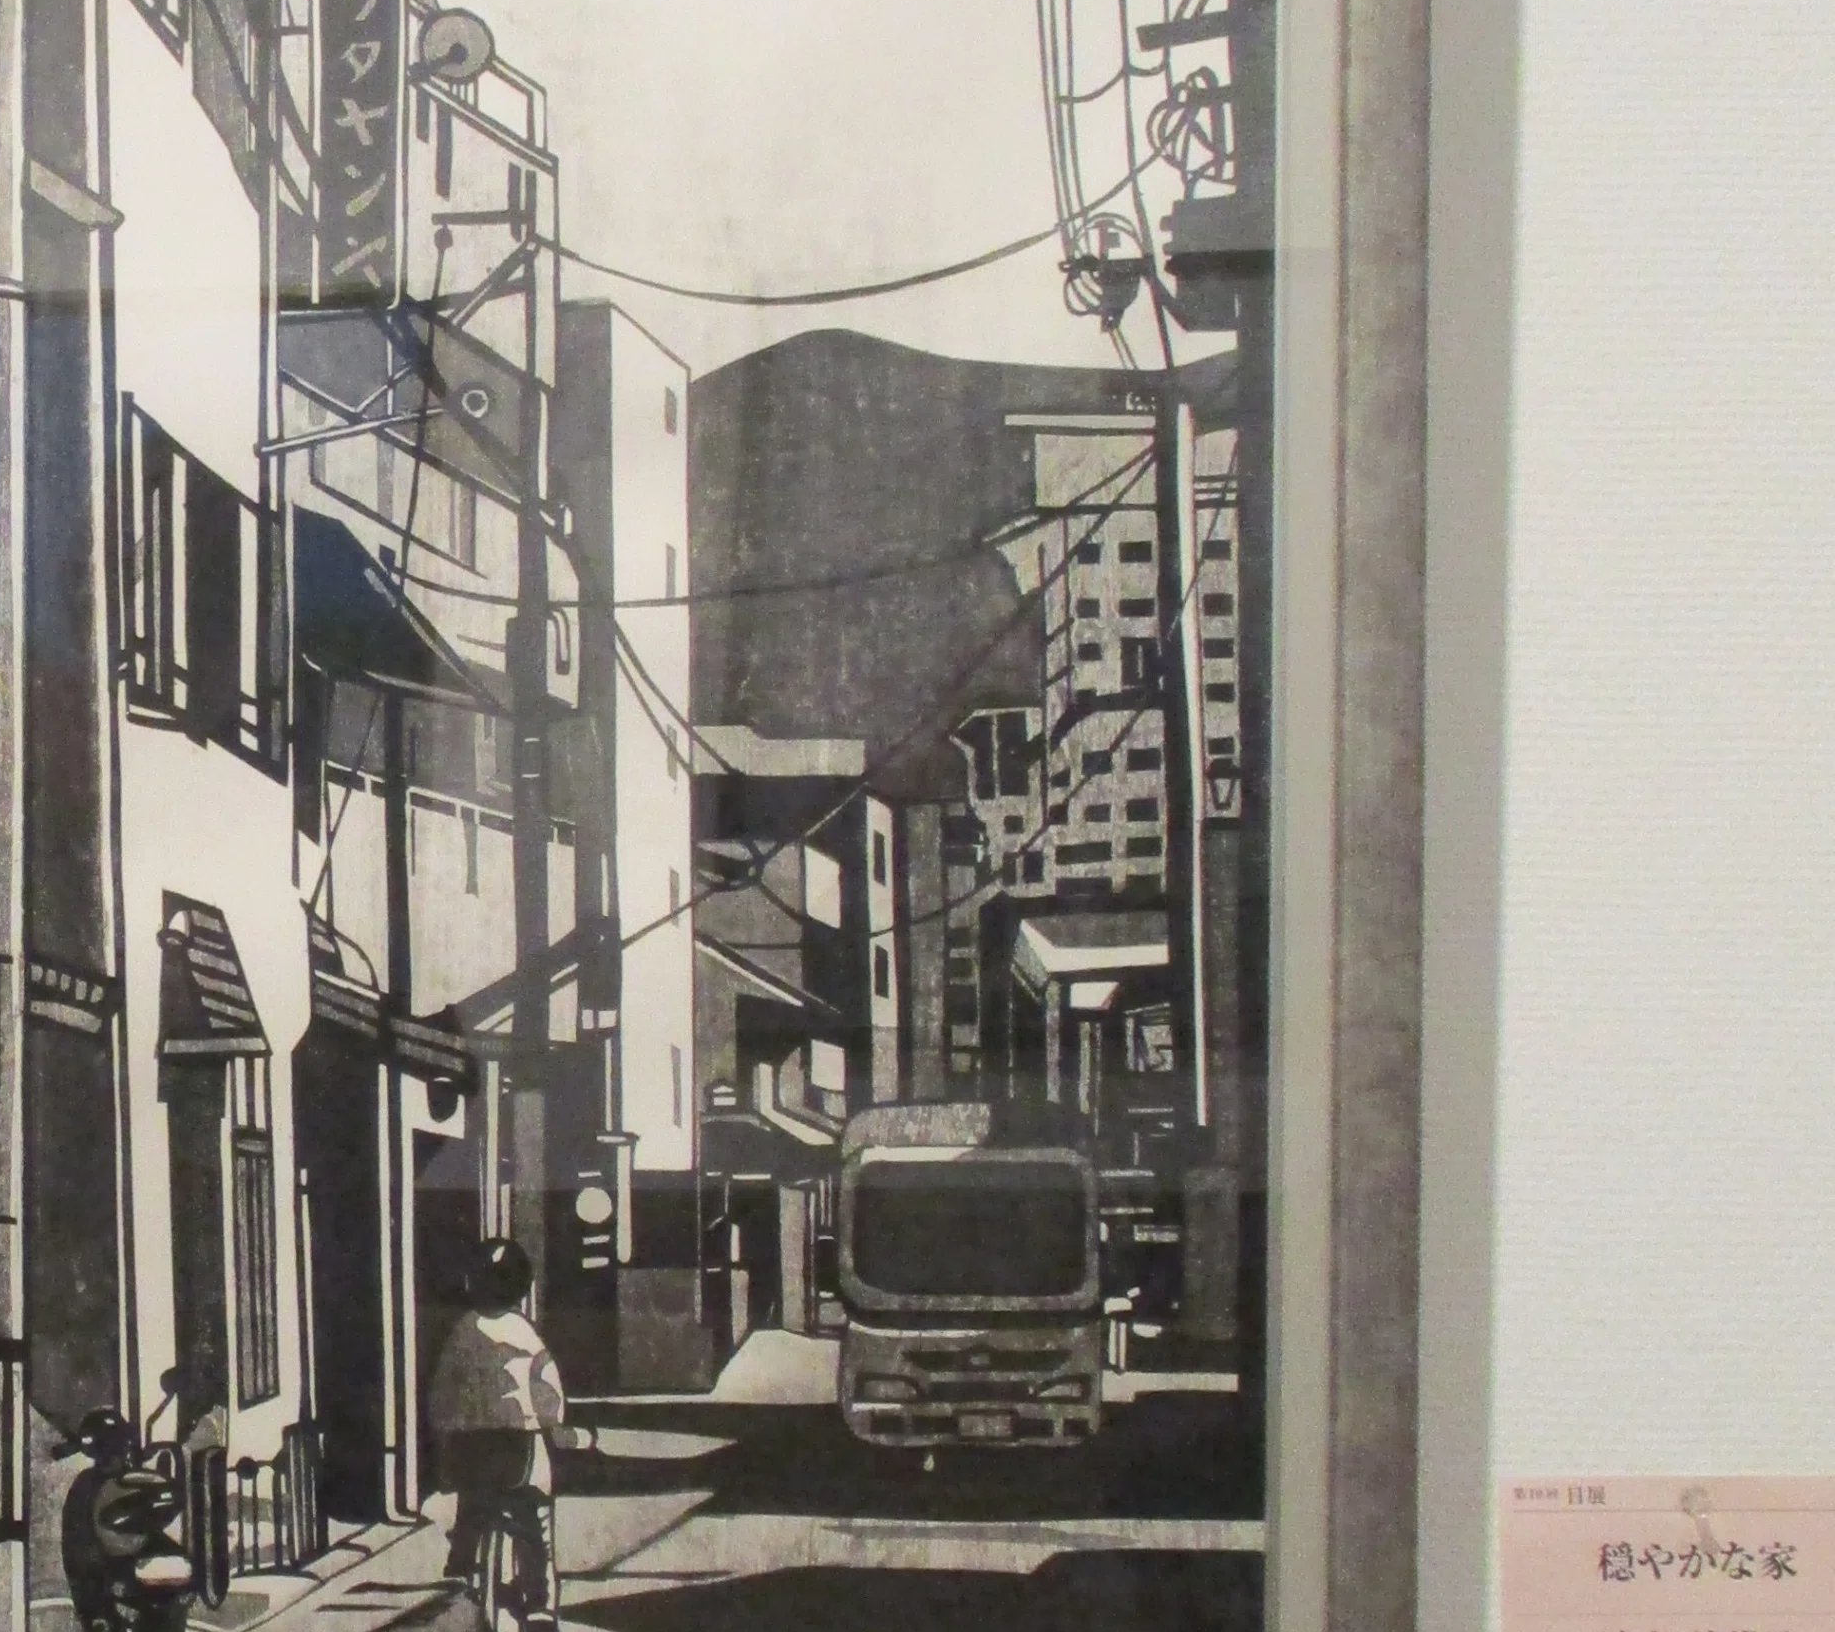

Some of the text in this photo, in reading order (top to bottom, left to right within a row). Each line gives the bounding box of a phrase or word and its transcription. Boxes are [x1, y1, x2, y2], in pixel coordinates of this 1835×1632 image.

[1567, 1484, 1606, 1506] 日展
[1598, 1540, 1798, 1582] 穏やかな家
